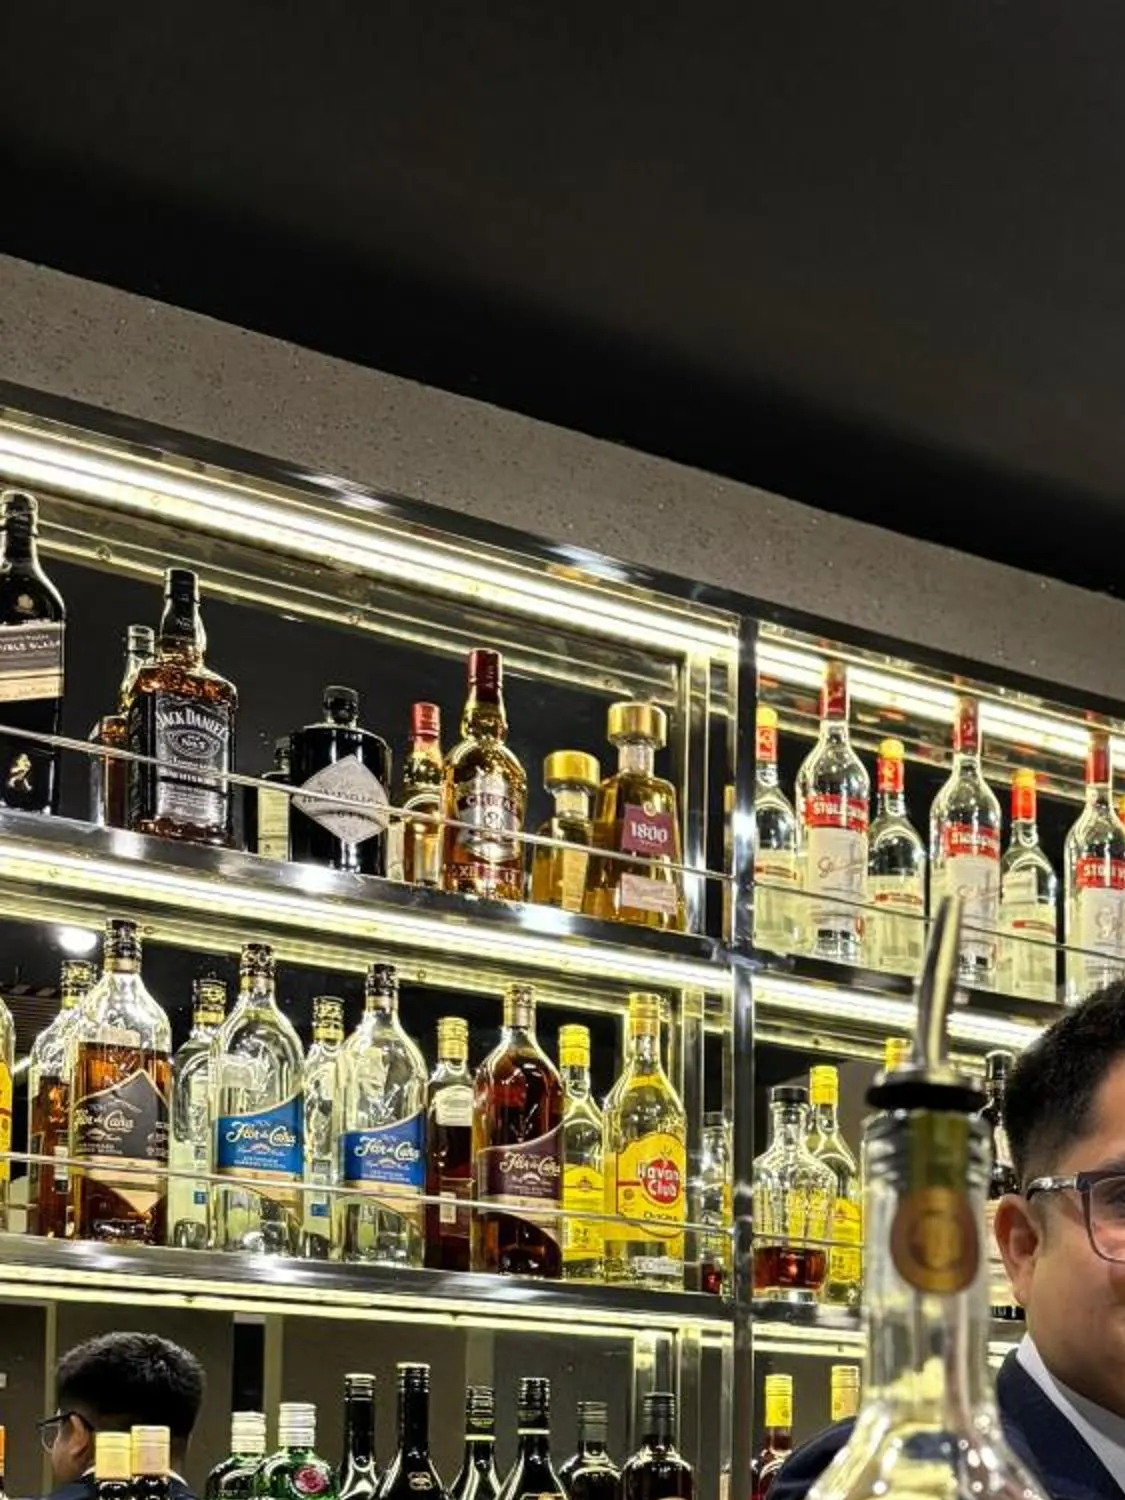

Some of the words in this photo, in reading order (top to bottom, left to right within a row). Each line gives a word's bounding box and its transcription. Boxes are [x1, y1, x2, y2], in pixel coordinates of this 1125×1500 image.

[156, 710, 186, 731] JACK
[631, 822, 669, 843] 1800
[648, 1180, 676, 1197] Club
